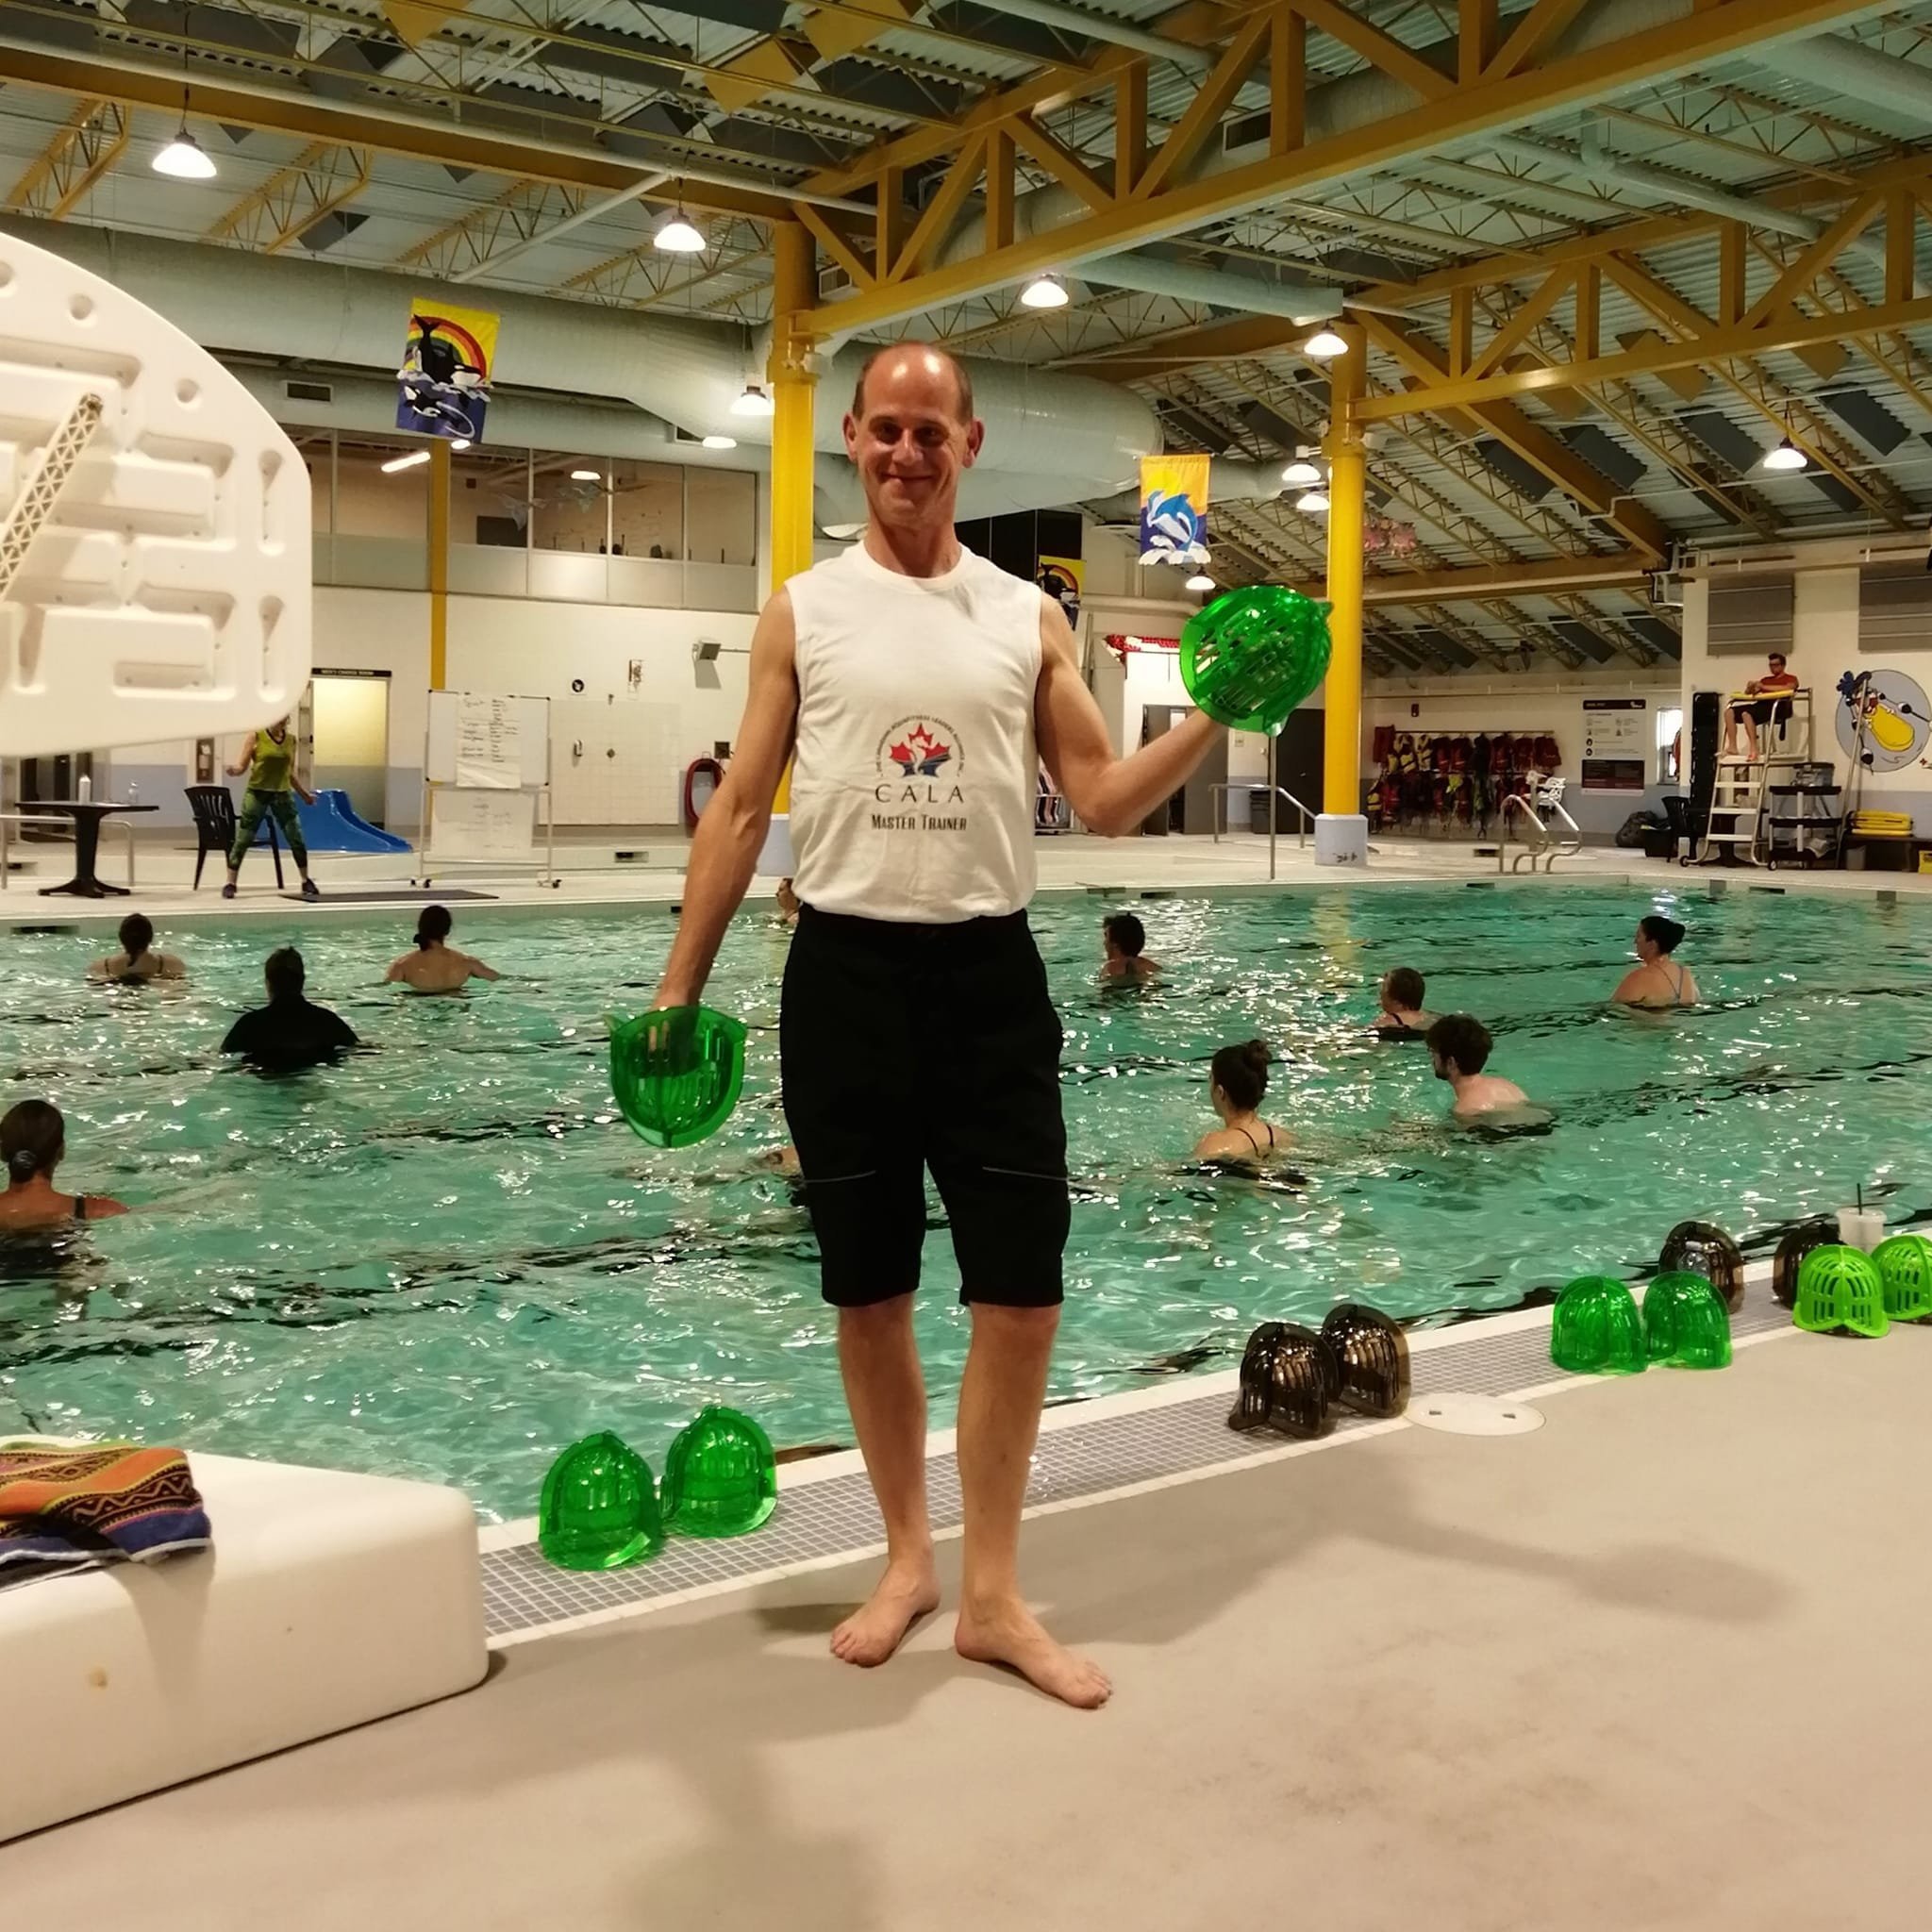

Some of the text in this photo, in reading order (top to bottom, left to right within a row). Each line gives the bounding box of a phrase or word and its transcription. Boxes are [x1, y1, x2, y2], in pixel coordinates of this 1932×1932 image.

[874, 784, 964, 803] CALA
[872, 814, 967, 830] MASTER TRAINER
